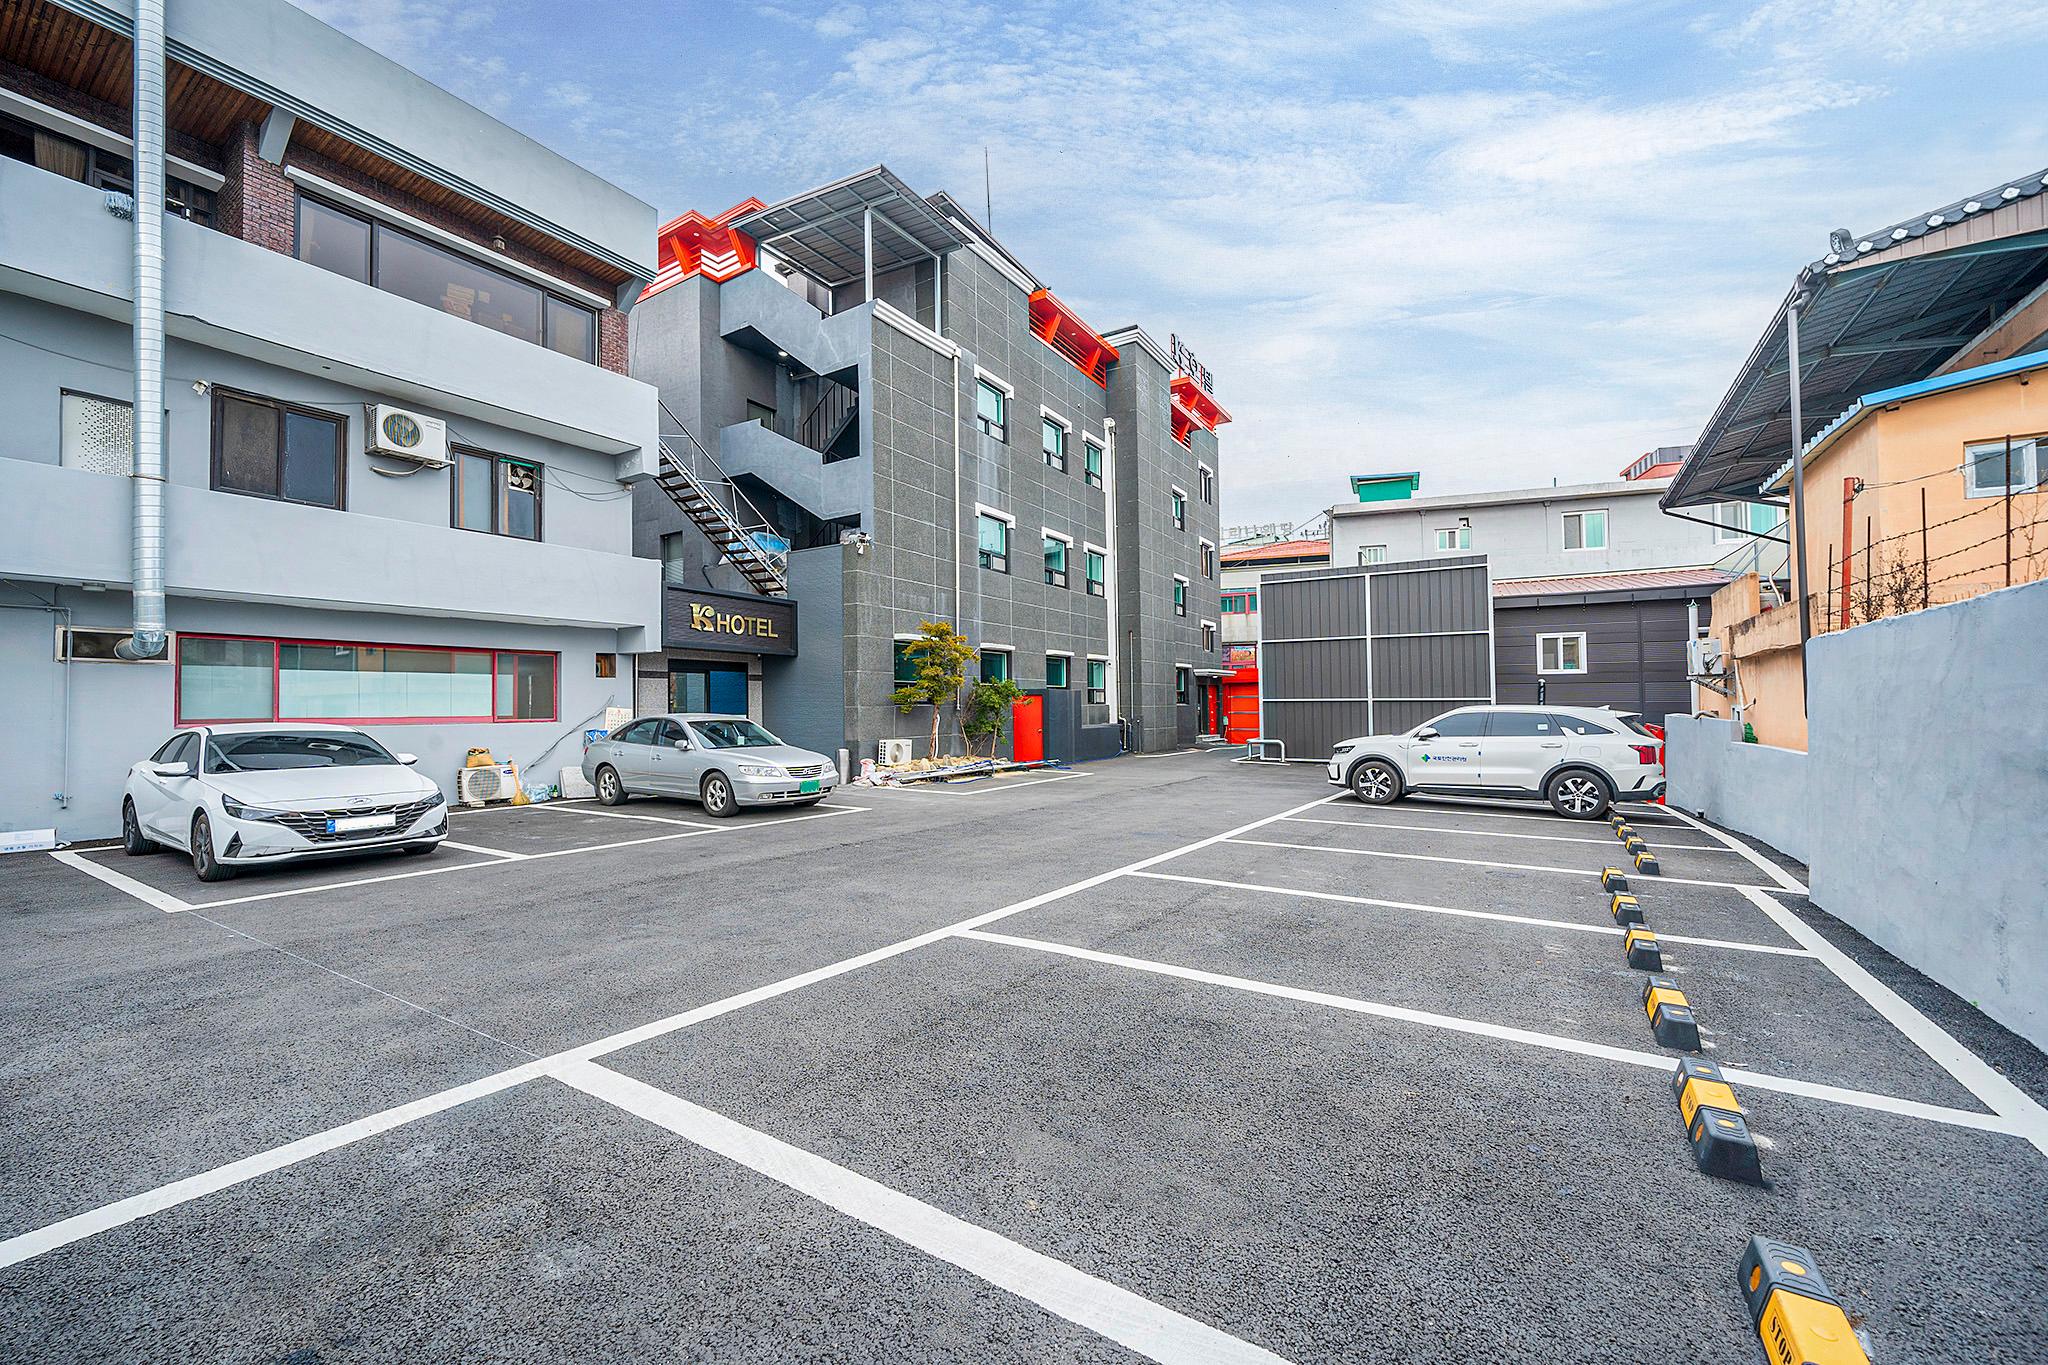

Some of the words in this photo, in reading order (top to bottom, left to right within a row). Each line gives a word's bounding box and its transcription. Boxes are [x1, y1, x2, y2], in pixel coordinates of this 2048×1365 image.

[689, 603, 715, 632] K
[716, 613, 779, 638] HOTEL
[1769, 1316, 1793, 1365] STOP
